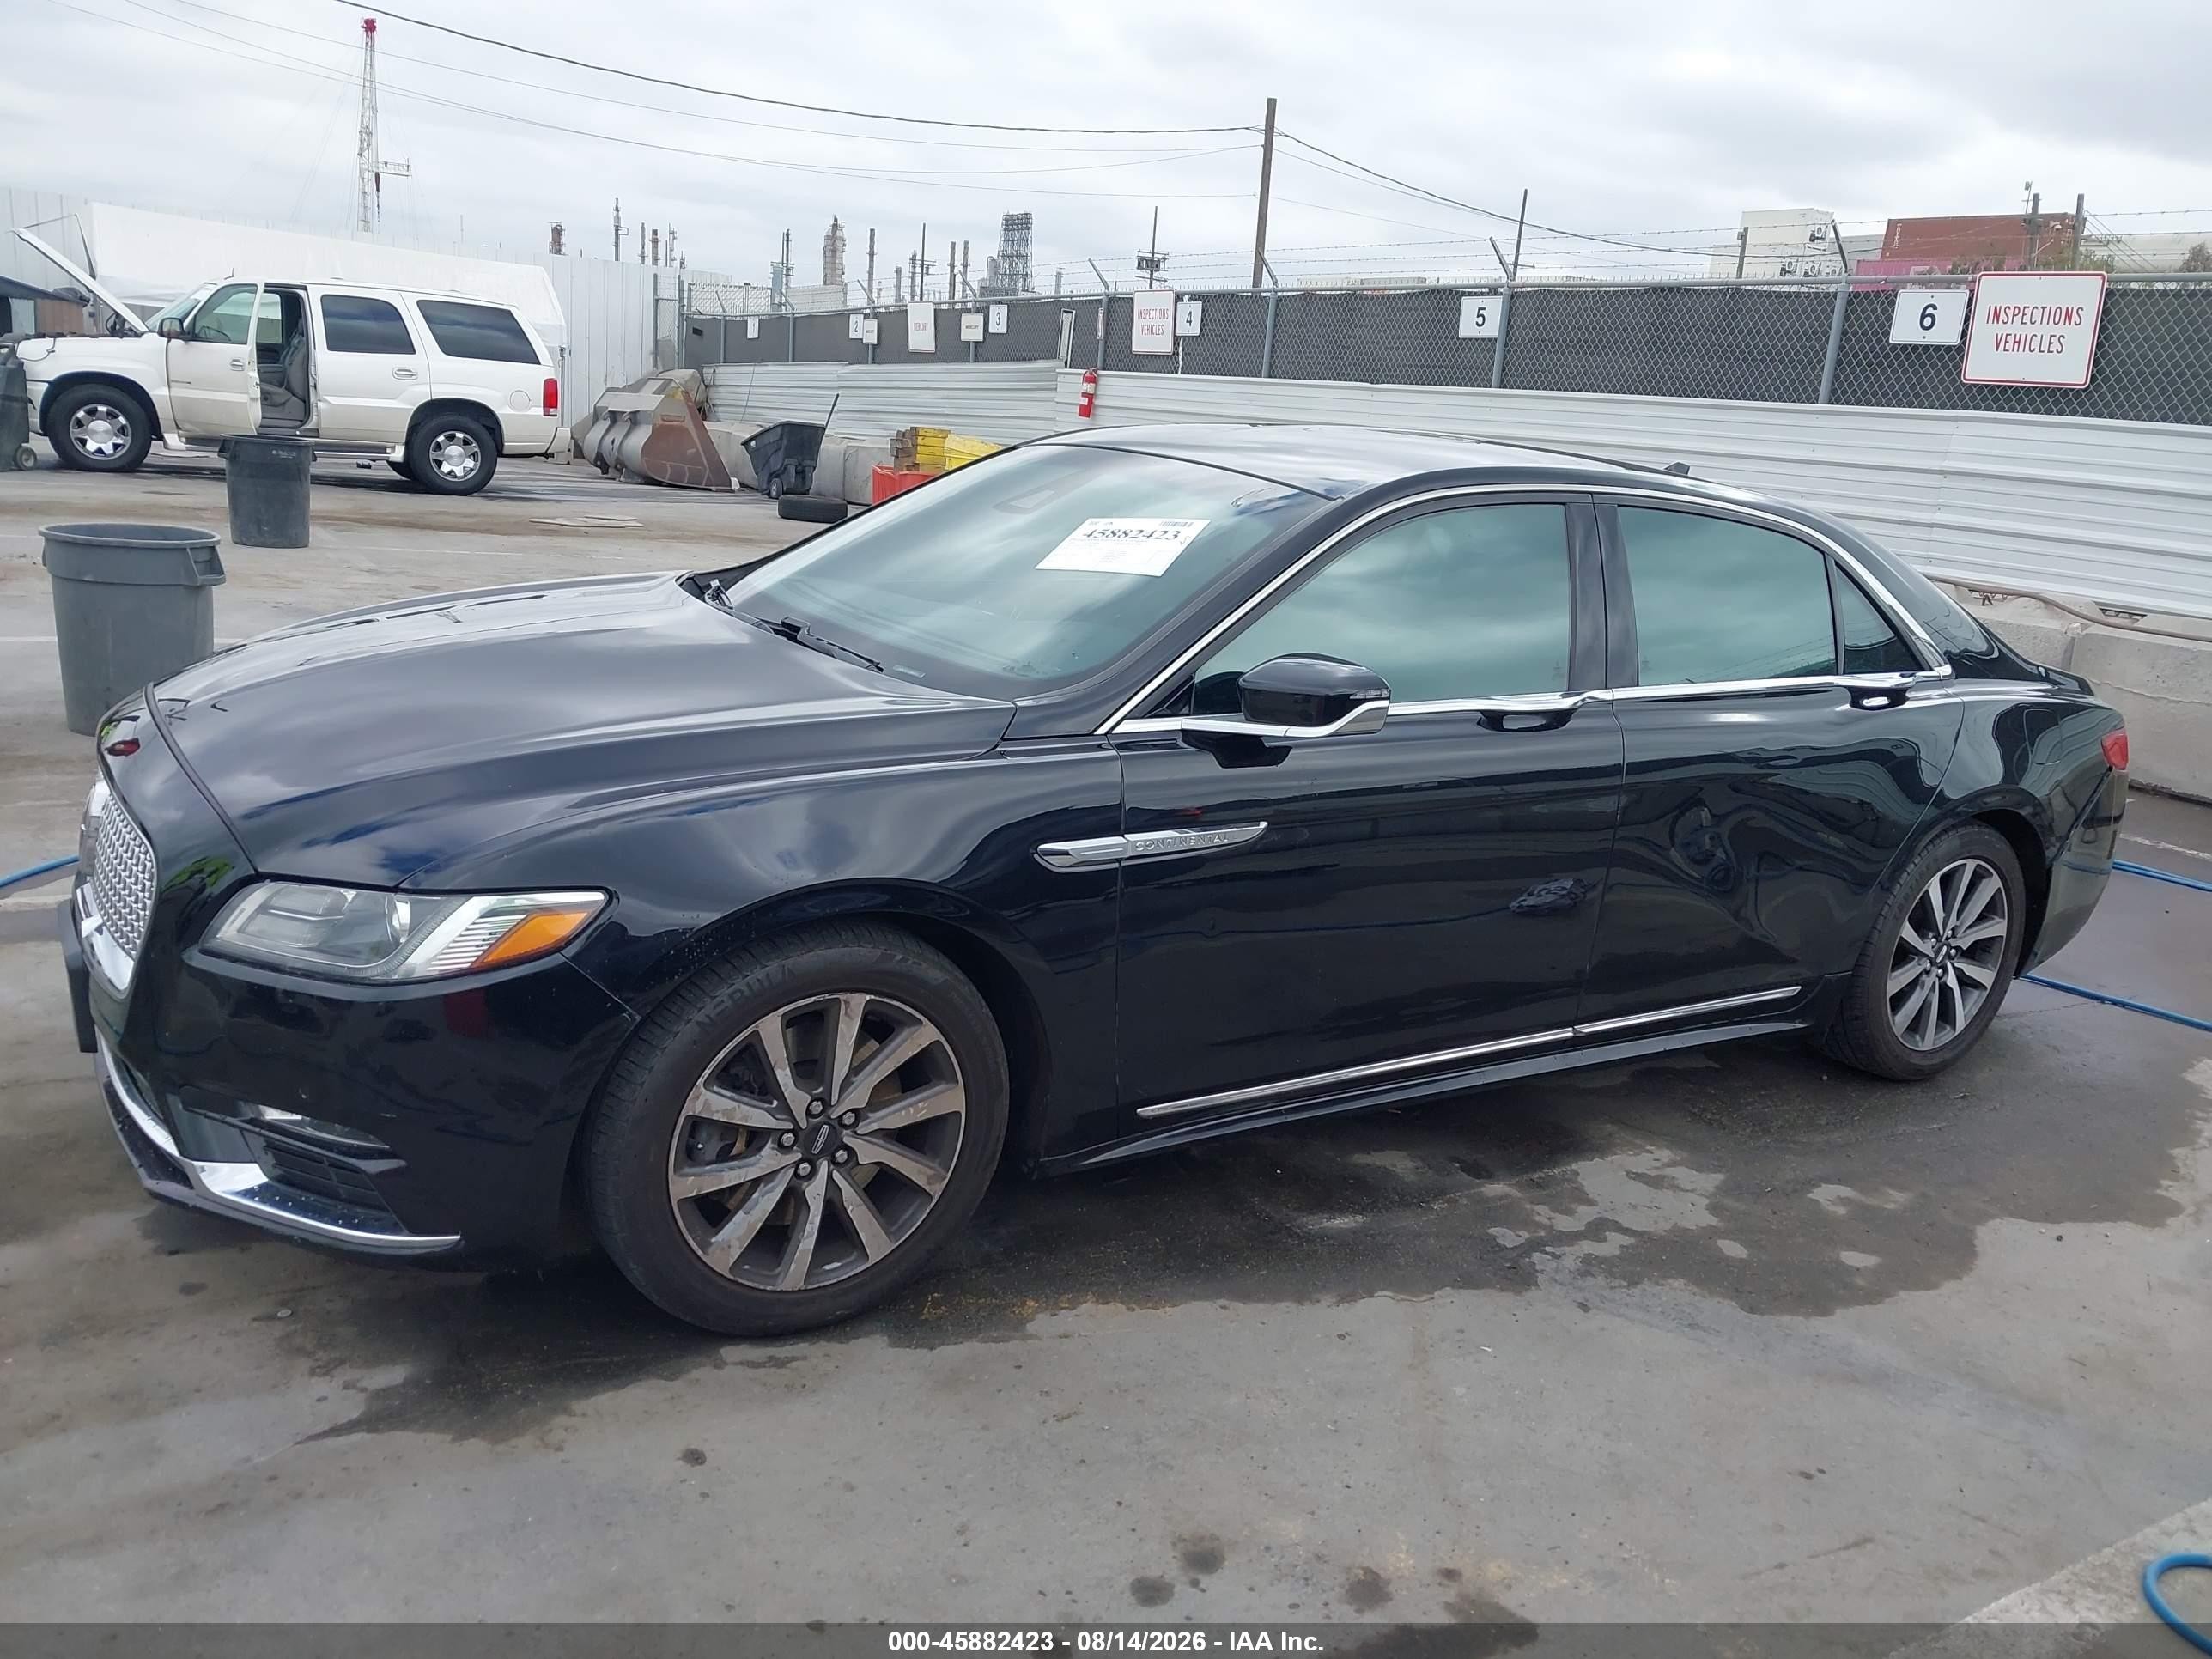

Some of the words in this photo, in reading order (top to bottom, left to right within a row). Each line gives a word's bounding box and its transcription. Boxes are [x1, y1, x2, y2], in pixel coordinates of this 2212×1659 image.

[995, 312, 1001, 326] 3
[1138, 308, 1169, 320] INSPECTIONS
[1186, 311, 1193, 327] 4
[1475, 307, 1486, 327] 5
[1919, 303, 1938, 331] 6
[1986, 305, 2084, 326] INSPECTIONS
[752, 323, 756, 333] 1
[854, 320, 859, 333] 2
[1140, 325, 1164, 336] VEHICLES
[1994, 333, 2066, 354] VEHICLES
[1082, 528, 1182, 540] 45882423
[1135, 833, 1229, 851] CONTINENTAL
